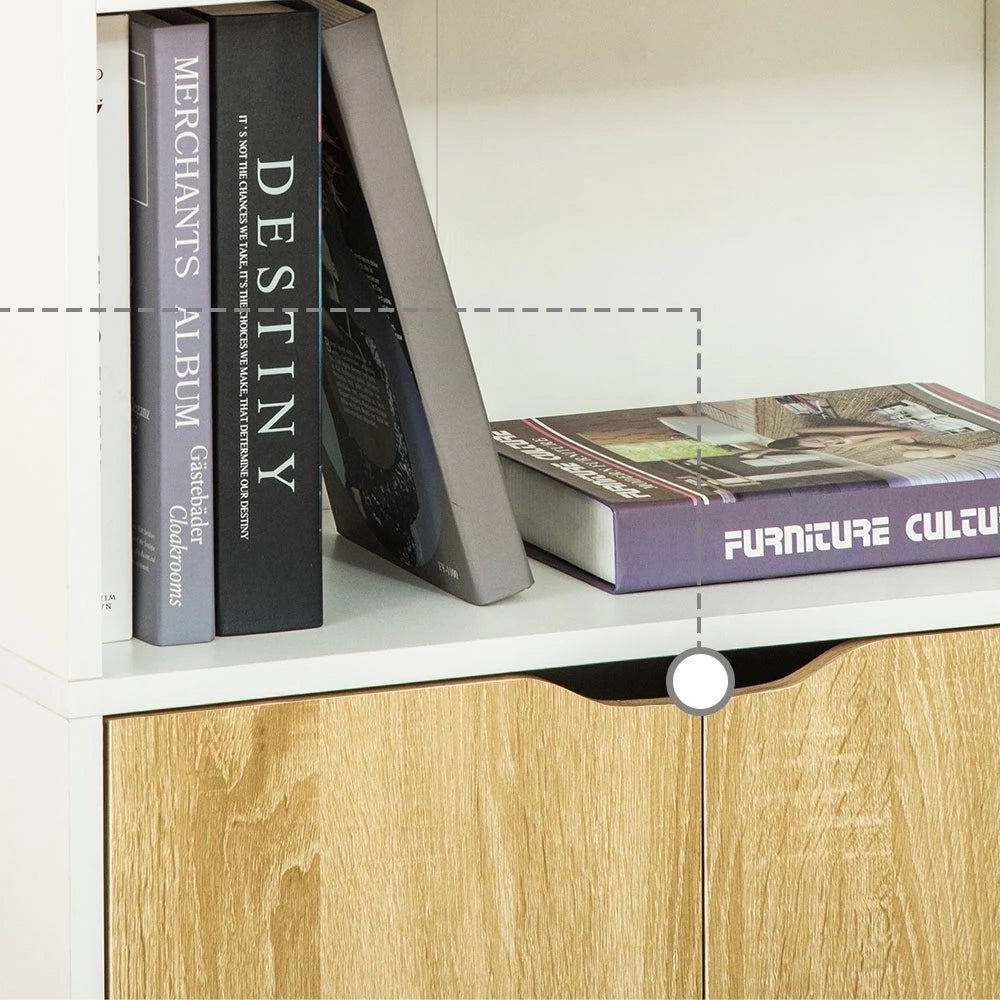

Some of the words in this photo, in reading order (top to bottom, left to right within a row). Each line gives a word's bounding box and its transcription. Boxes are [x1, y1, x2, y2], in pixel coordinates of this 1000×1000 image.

[174, 56, 201, 278] MERCHANTS
[239, 140, 249, 160] NOT
[239, 161, 249, 179] THE
[239, 180, 249, 224] CHANCES
[239, 225, 249, 241] WE
[239, 242, 249, 269] TAKE,
[239, 289, 249, 308] THE
[239, 309, 249, 349] CHOICES
[256, 154, 295, 492] DESTINY
[174, 304, 201, 429] ALBUM
[239, 350, 249, 365] WE
[239, 366, 249, 397] MAKE,
[239, 398, 249, 423] THAT
[239, 424, 249, 478] DETERMINE
[190, 445, 209, 545] Gästebäder
[239, 479, 249, 499] OUR
[239, 500, 249, 540] DESTINY
[905, 506, 1000, 542] CULTU
[169, 504, 188, 607] Cloakrooms
